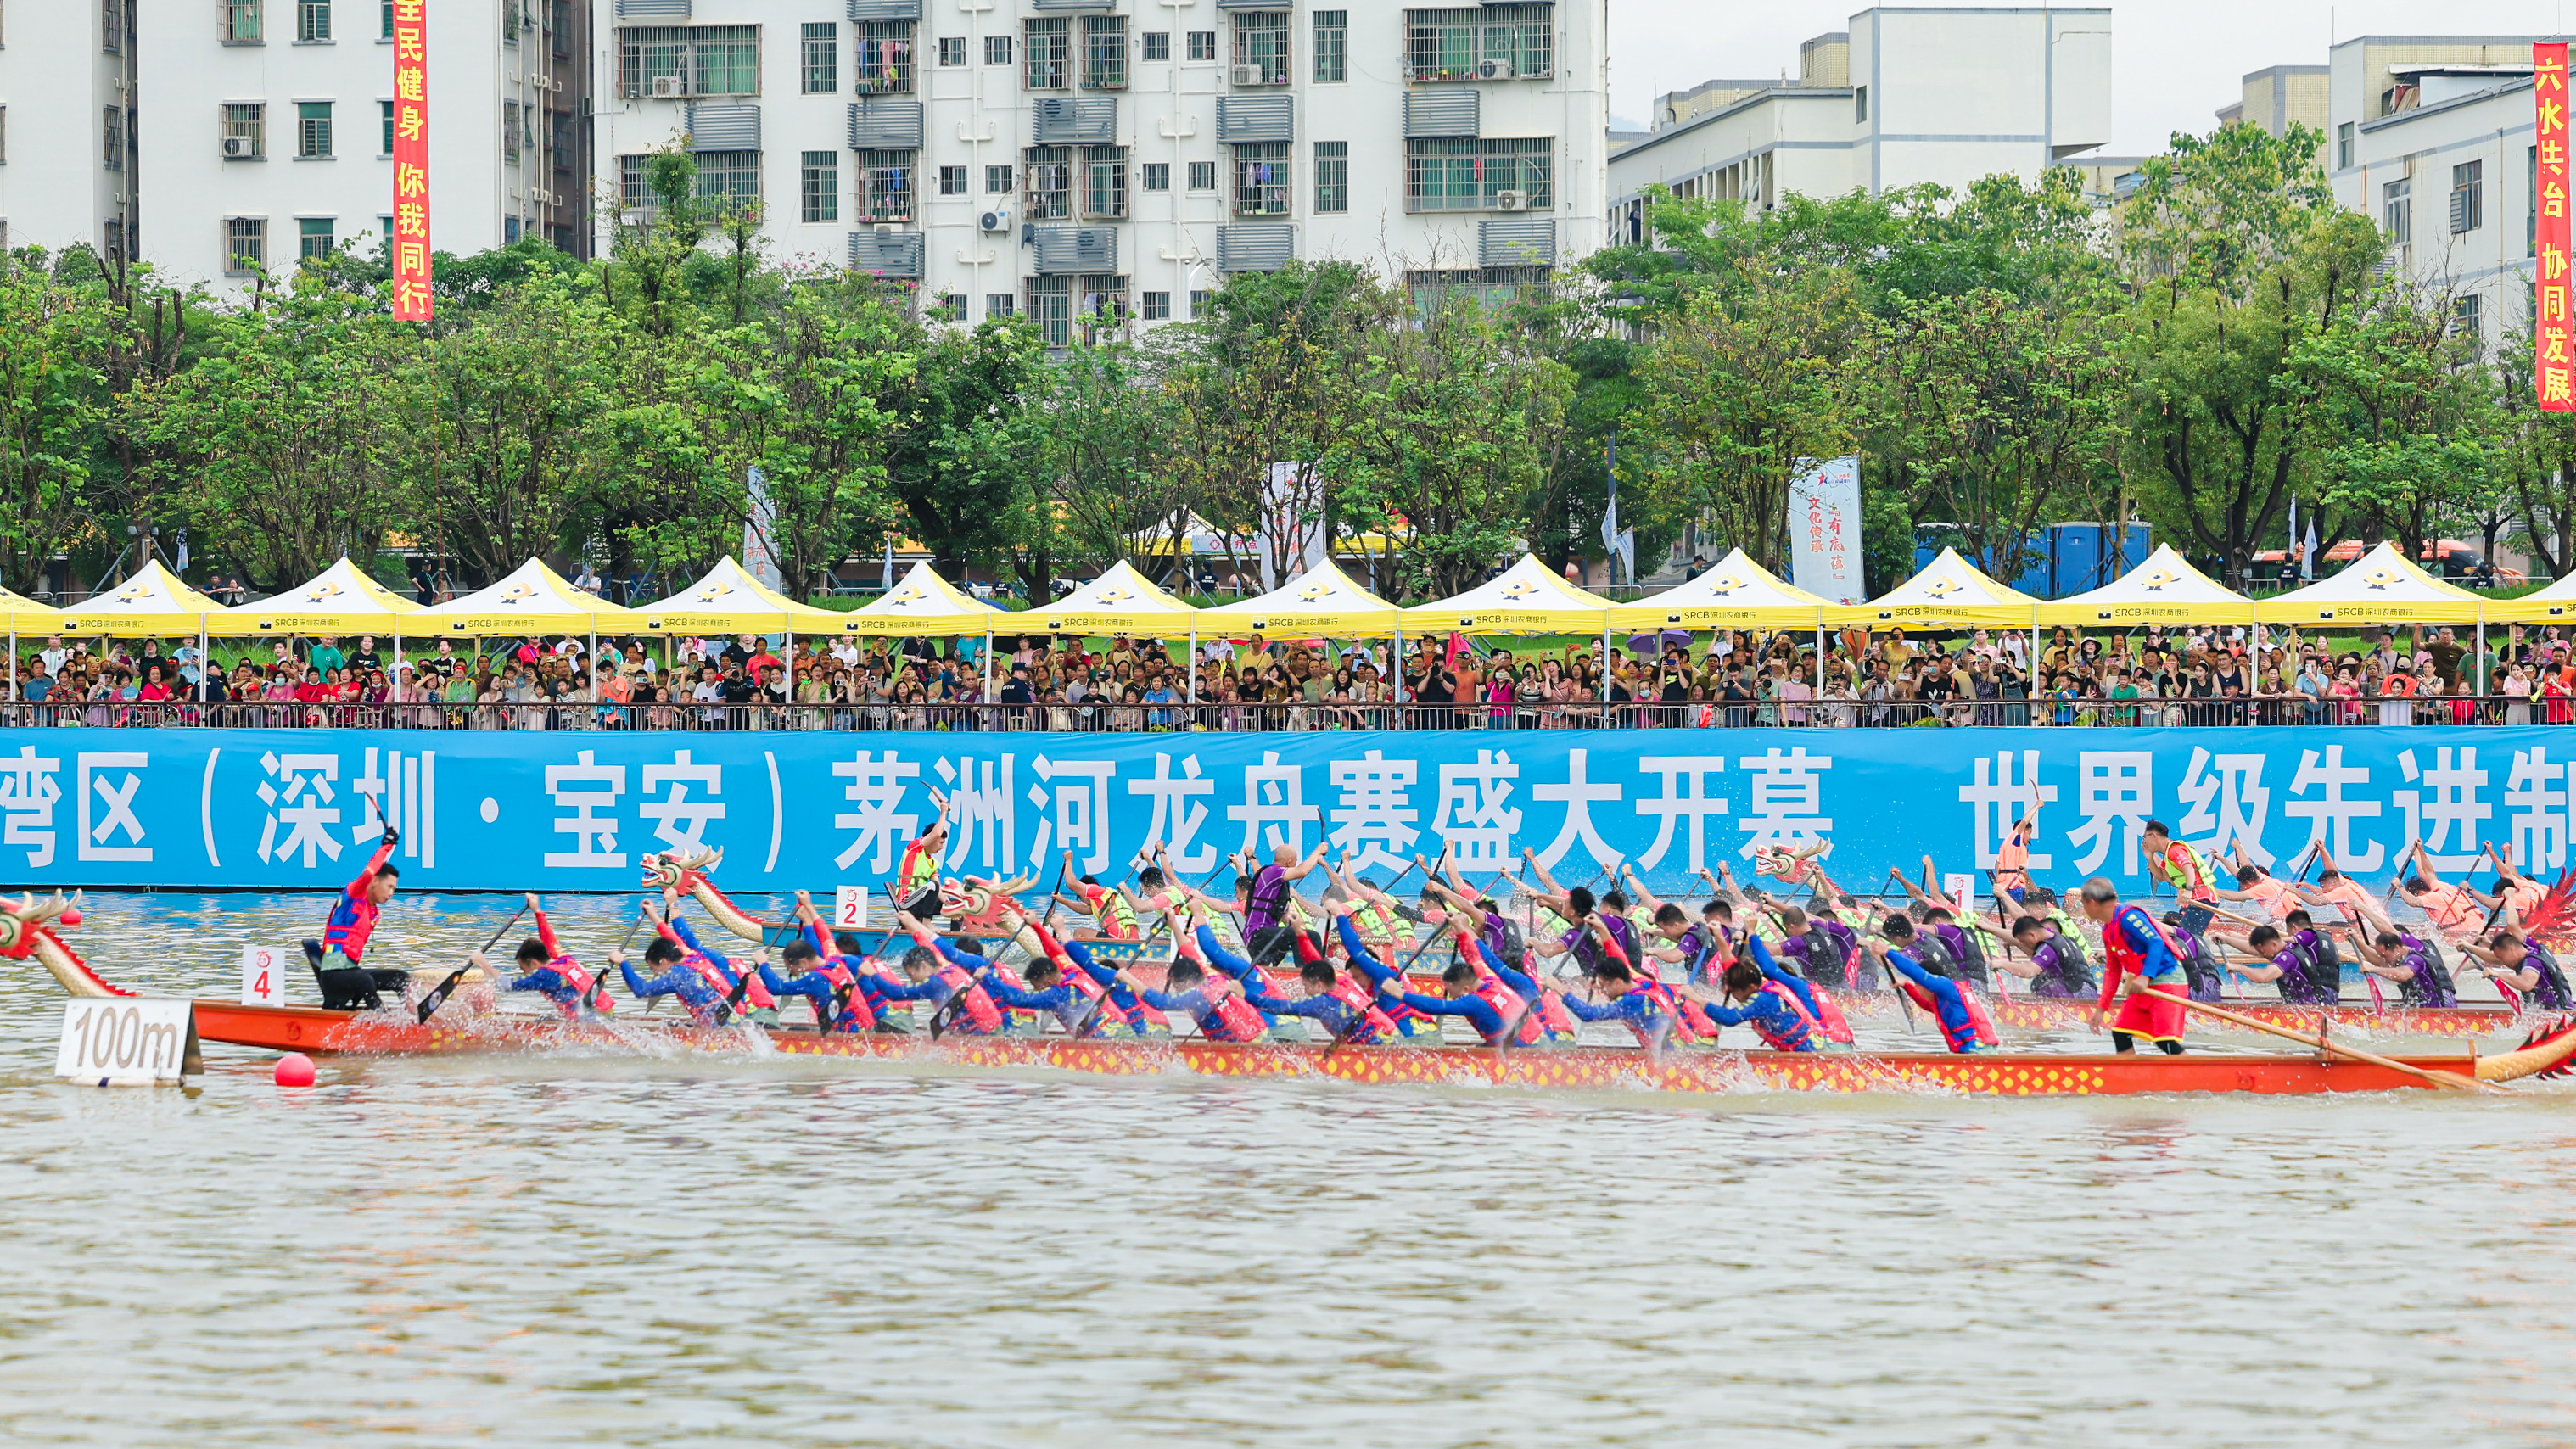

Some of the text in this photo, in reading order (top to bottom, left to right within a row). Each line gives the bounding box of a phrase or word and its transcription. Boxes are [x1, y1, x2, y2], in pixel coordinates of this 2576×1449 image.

[397, 162, 428, 315] 你我同行
[2541, 243, 2573, 404] 协同发展
[1684, 611, 1756, 620] SRCB 深圳农商银行
[1895, 607, 1968, 618] SRCB 深圳农商银行
[2114, 608, 2189, 618] SRCB 深圳农商银行
[2337, 607, 2413, 617] SRCB 深圳农商银行
[80, 619, 144, 629] SRCB 深圳农商银行
[275, 618, 340, 628] SRCB 深圳农商银行
[468, 619, 535, 628] SRCB 深圳农商银行
[664, 618, 731, 628] SRCB 深圳农商银行
[861, 620, 929, 629] SRCB 深圳农商银行
[1064, 618, 1133, 628] SRCB 深圳农商银行
[1268, 618, 1338, 627] SRCB 深圳农商银行
[1476, 615, 1547, 624] SRCB 深圳农商银行
[1955, 889, 1962, 908] 1
[843, 903, 857, 924] 2
[254, 970, 271, 999] 4
[75, 1007, 177, 1069] 100m
